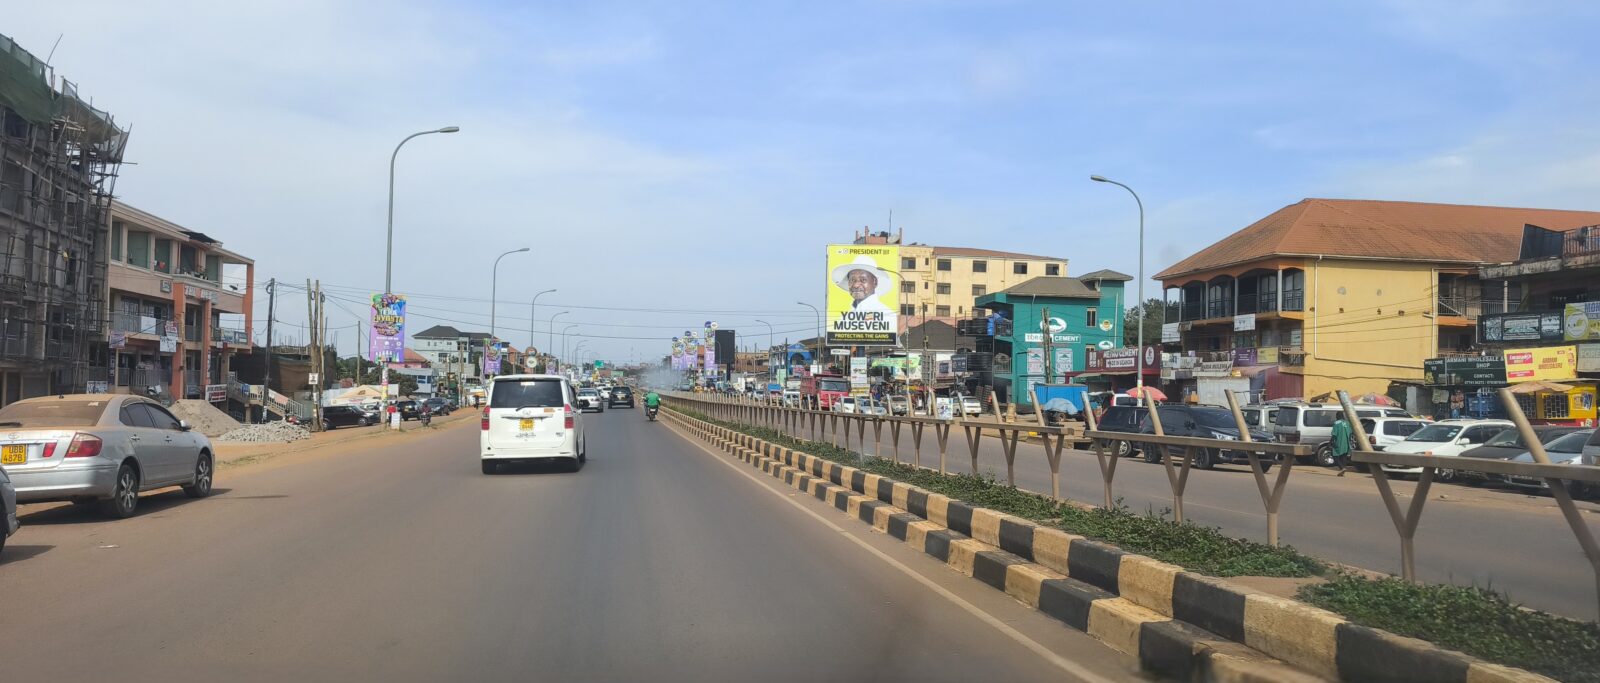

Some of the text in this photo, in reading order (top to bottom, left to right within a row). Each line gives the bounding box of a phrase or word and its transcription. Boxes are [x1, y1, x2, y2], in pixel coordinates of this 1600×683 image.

[834, 321, 889, 331] MUSEVENI
[1119, 349, 1139, 357] CEMENT
[1468, 355, 1499, 363] WHOLESALE
